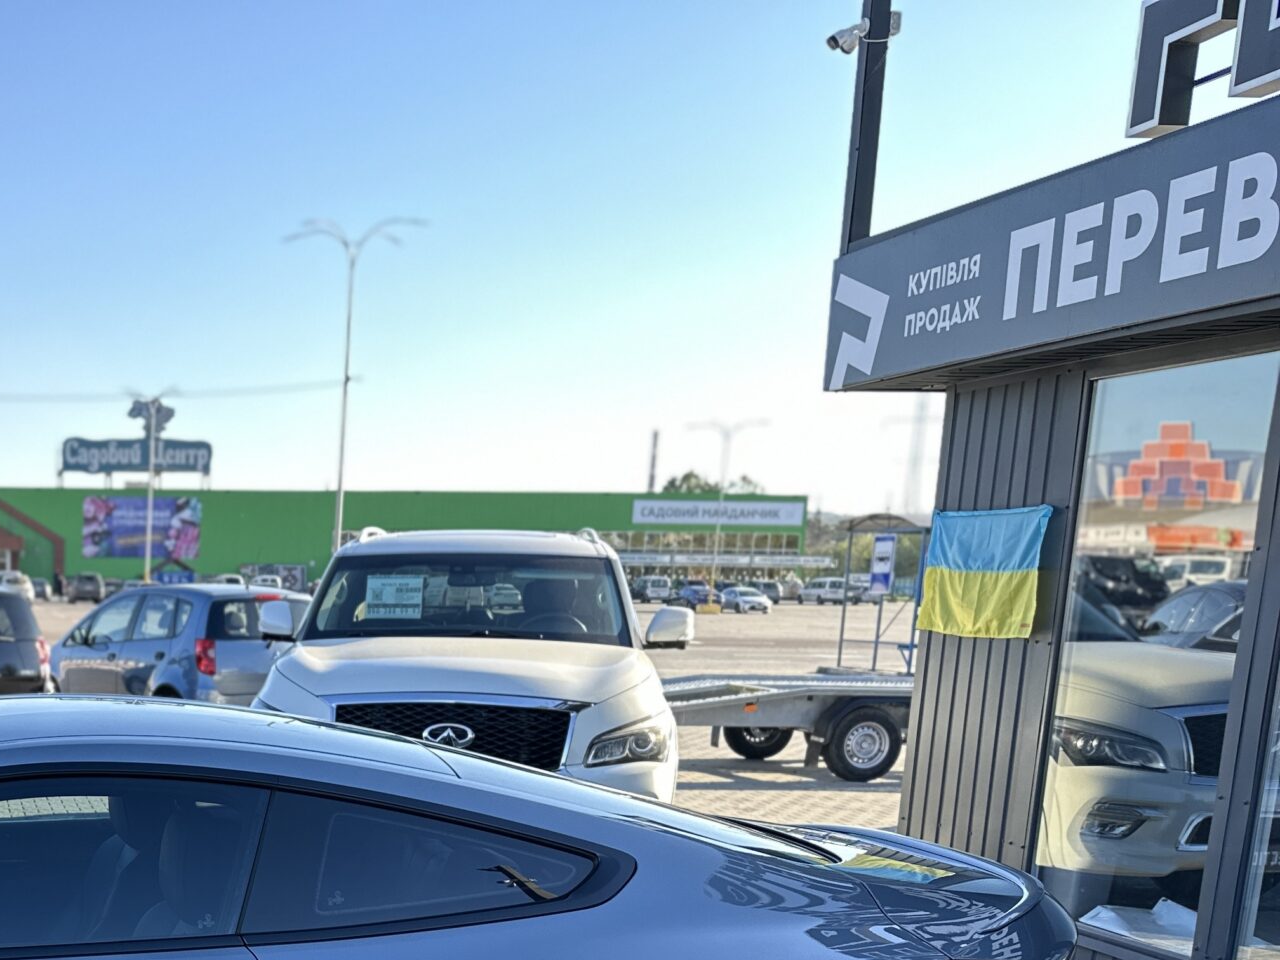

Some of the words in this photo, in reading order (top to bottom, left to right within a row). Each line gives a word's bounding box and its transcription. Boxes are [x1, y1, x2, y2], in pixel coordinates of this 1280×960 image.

[907, 253, 981, 297] КУПІВЛЯ
[903, 295, 982, 338] ПРОДАЖ
[640, 504, 699, 519] САДОВИЙ
[701, 505, 781, 521] МАЙДАНЧИК
